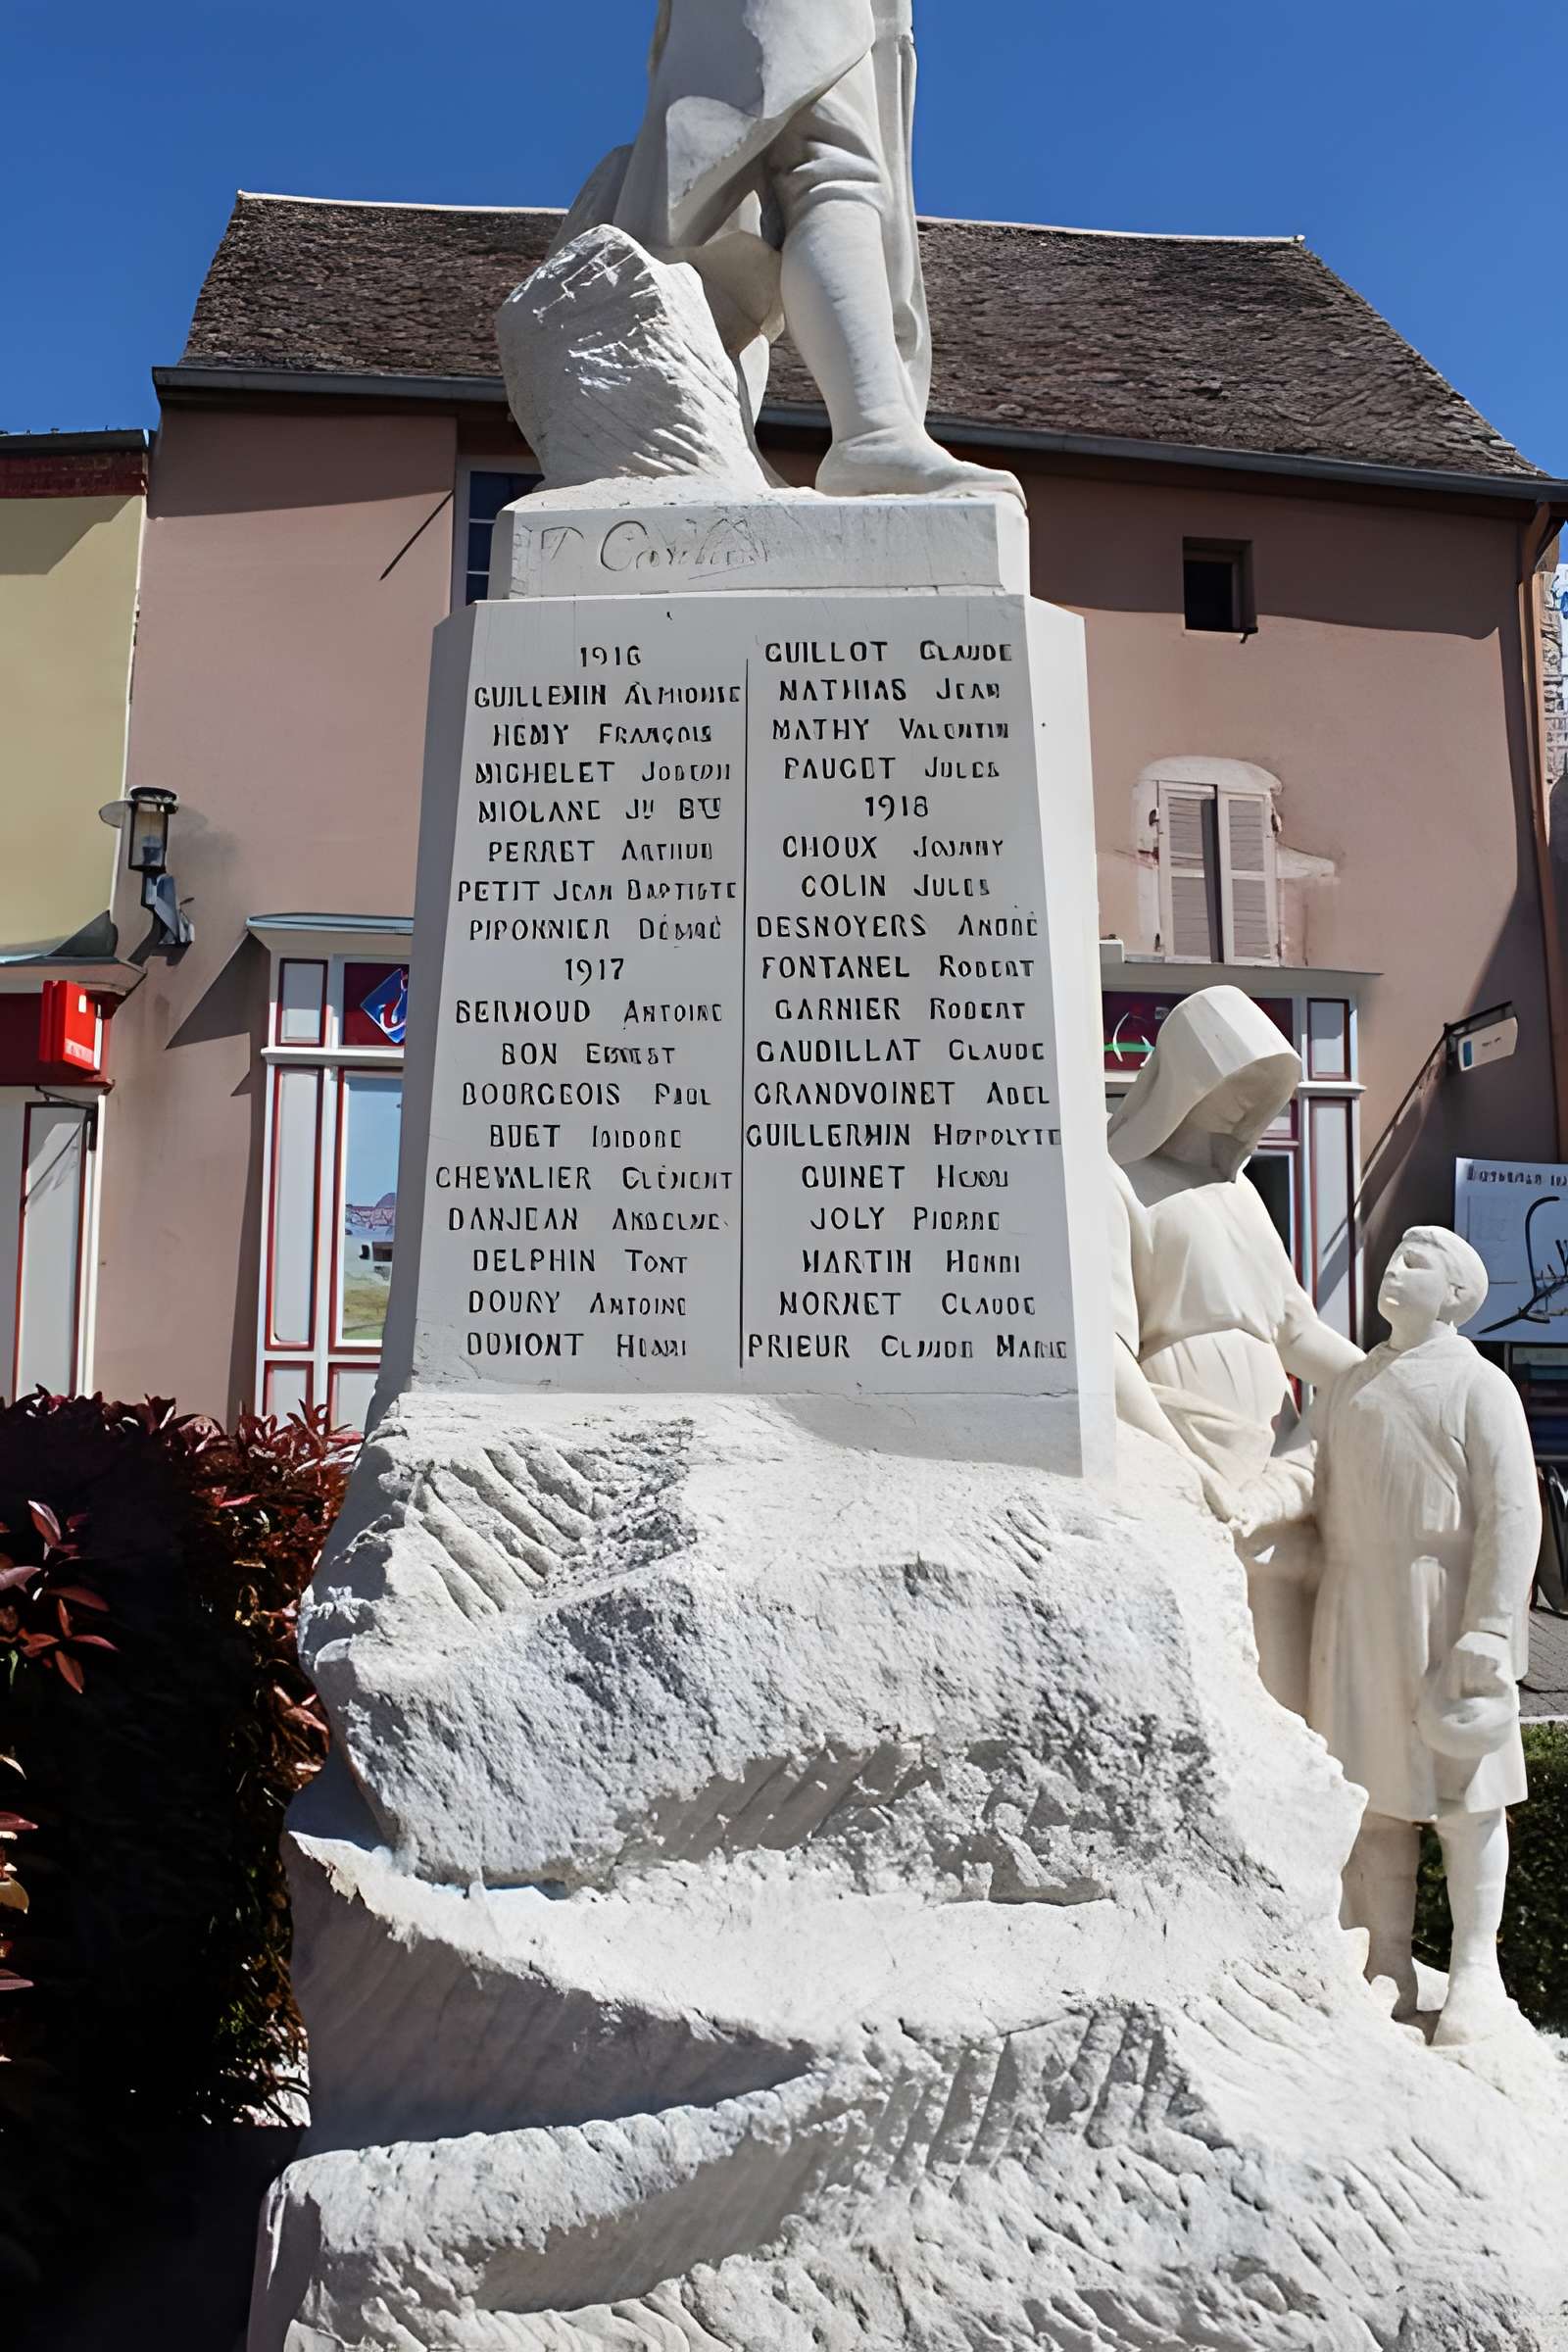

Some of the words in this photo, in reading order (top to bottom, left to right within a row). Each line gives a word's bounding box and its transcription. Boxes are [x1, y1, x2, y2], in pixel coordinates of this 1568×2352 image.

[579, 644, 642, 668] 1916
[764, 640, 889, 664] GUILLOT
[772, 717, 870, 741] MATHY
[474, 760, 616, 787] MICHELET
[864, 794, 929, 822] 1918
[488, 838, 596, 863] PERRET
[782, 834, 878, 859] CHOUX
[457, 880, 541, 903] PETIT
[801, 872, 886, 899] COLIN
[757, 912, 927, 941] DESNOYERS
[564, 957, 624, 988] 1917
[761, 954, 910, 980] FONTANEL
[774, 997, 902, 1021] GARNIER
[501, 1042, 558, 1067] BON
[462, 1081, 620, 1106] BOURGEOIS
[489, 1123, 562, 1149] BUET
[435, 1165, 592, 1191] CHEVALIER
[809, 1205, 886, 1231] JOLY
[472, 1248, 596, 1273] DELPHIN
[802, 1249, 911, 1275] MARTIN
[468, 1288, 561, 1314] DOURY
[748, 1333, 851, 1359] PRIEUR
